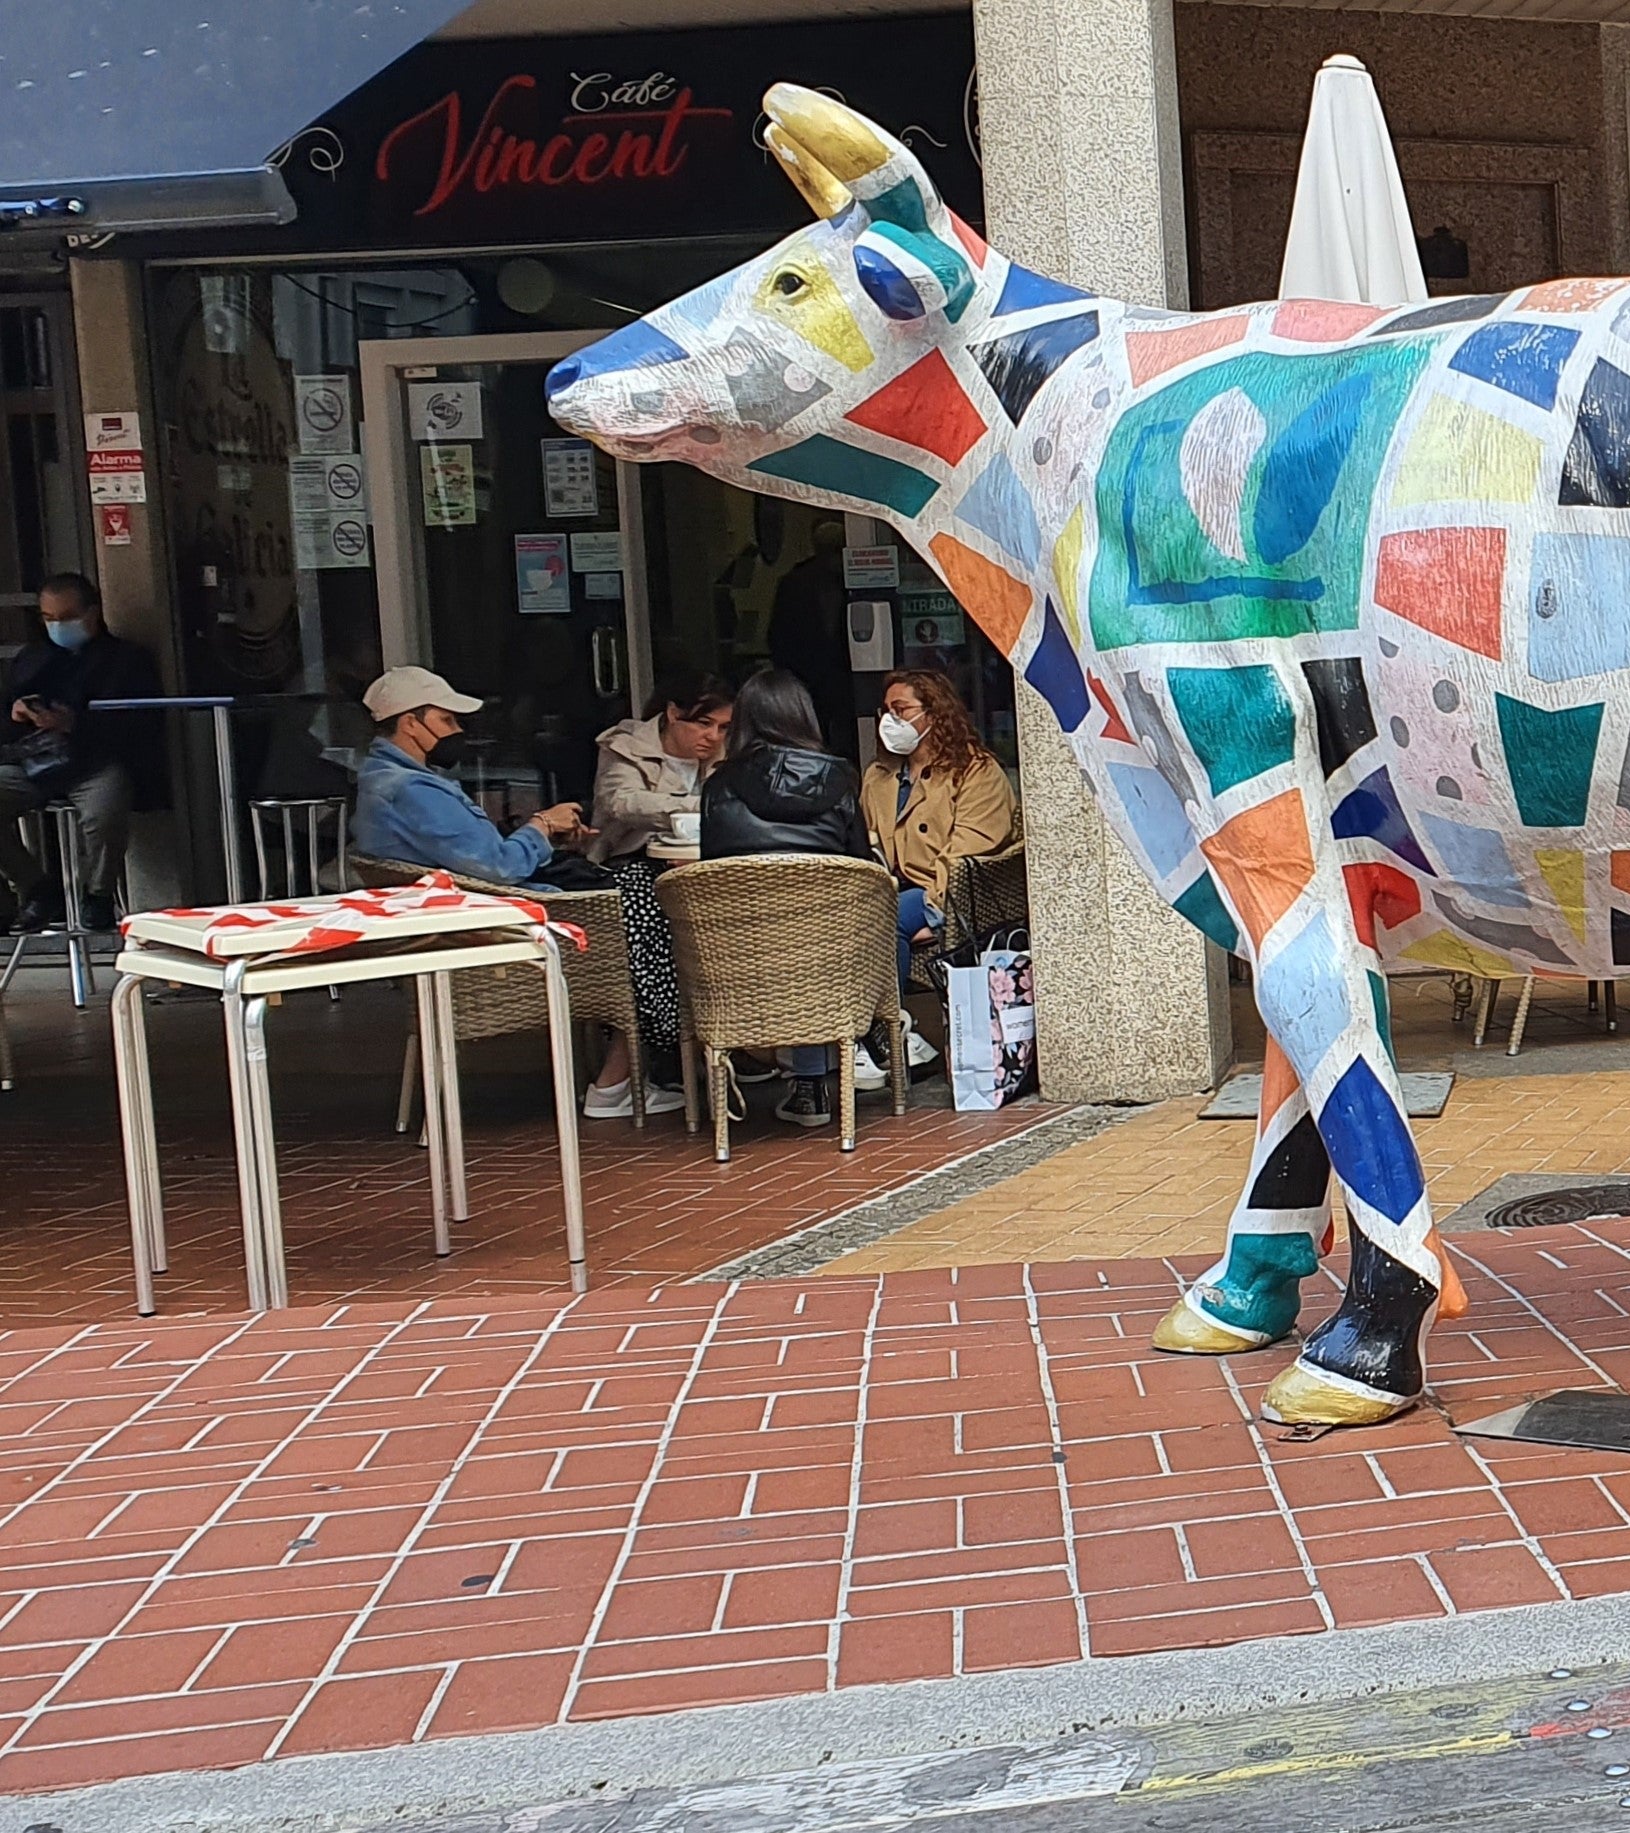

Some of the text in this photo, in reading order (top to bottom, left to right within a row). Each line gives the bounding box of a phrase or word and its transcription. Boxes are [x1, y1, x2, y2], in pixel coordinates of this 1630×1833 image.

[570, 72, 677, 113] Café
[376, 74, 733, 216] Vincent
[90, 453, 142, 465] Alarma
